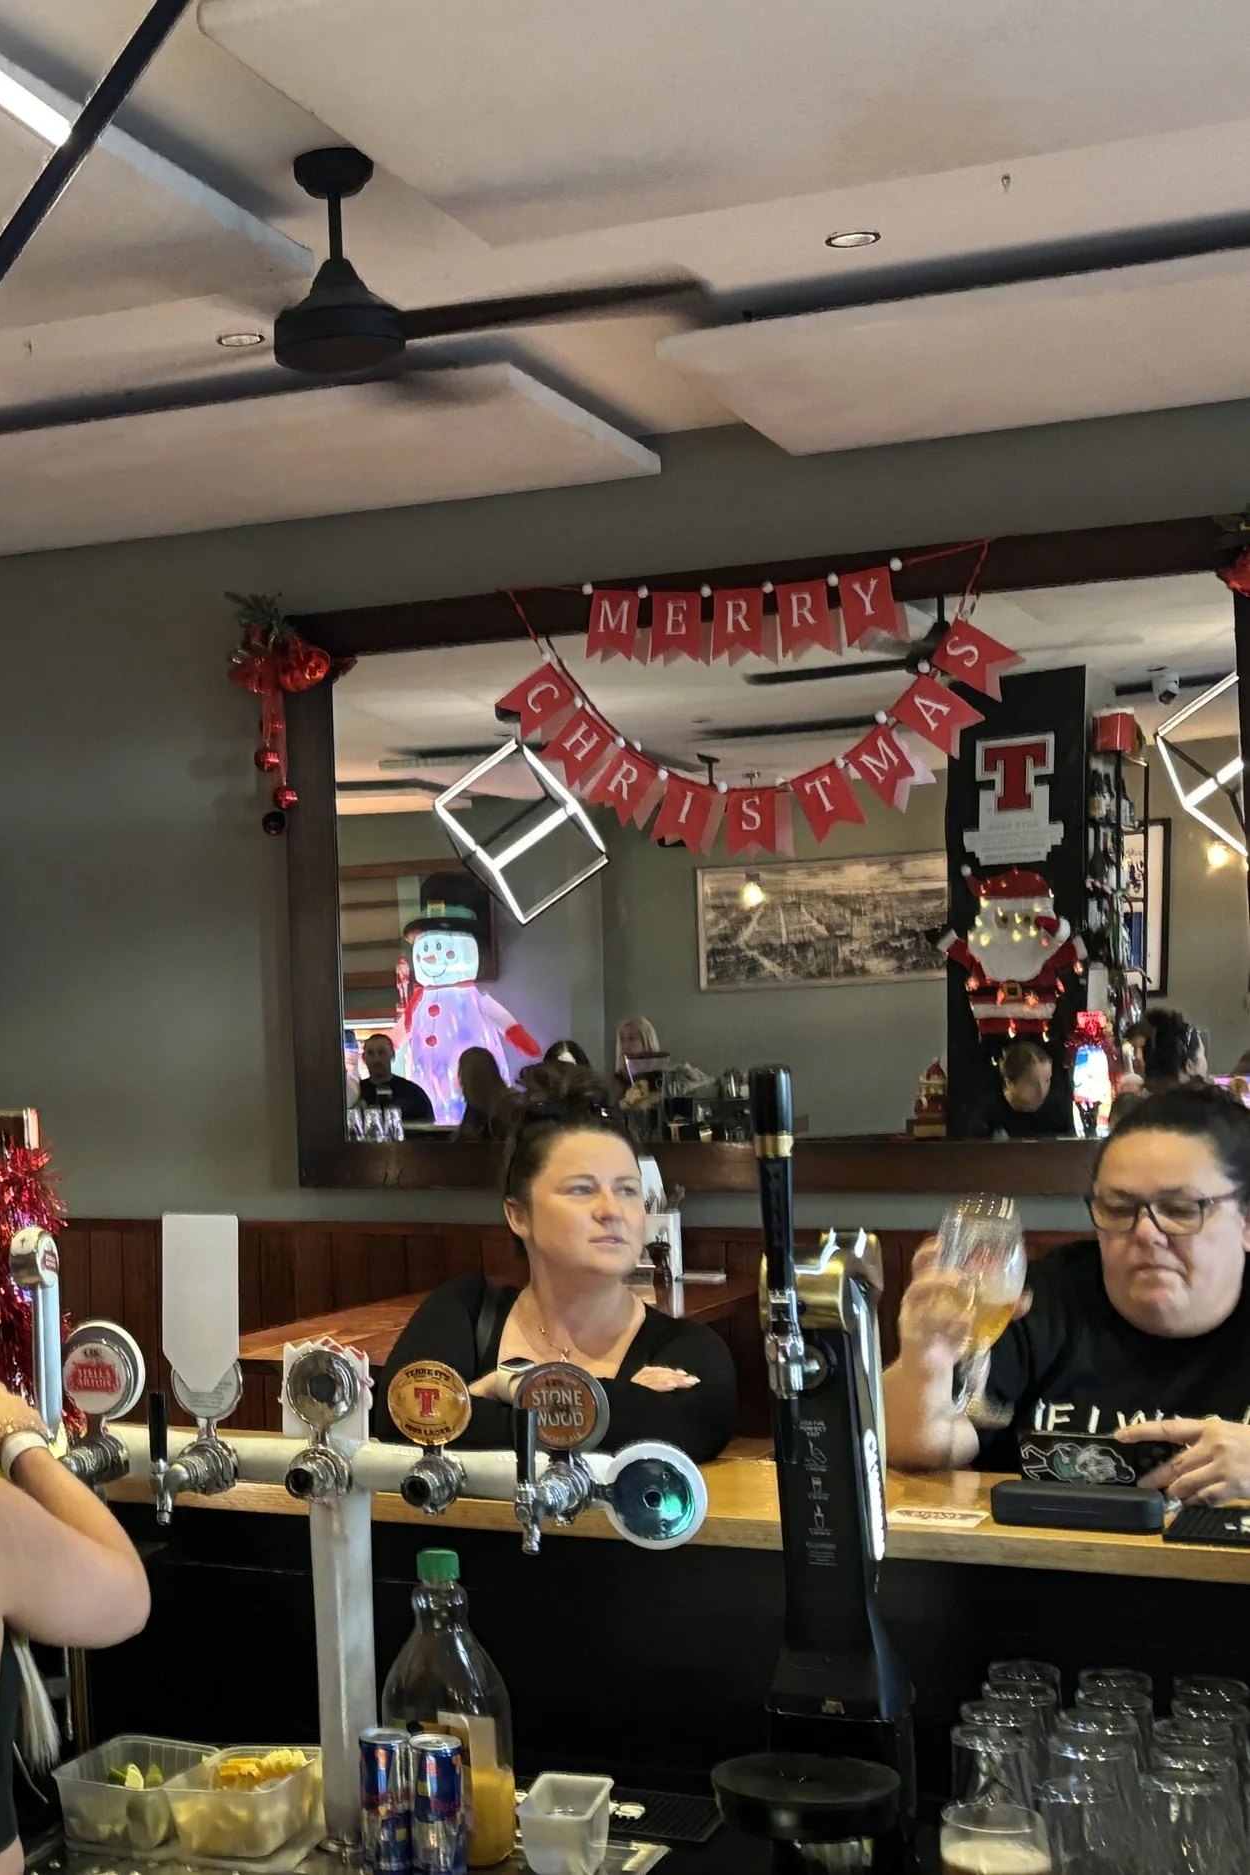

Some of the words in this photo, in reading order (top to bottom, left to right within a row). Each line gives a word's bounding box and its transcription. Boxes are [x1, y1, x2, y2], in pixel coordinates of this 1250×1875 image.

[597, 577, 880, 635] MERRY
[526, 636, 979, 831] CHRISTMAS
[414, 1387, 440, 1418] T
[531, 1389, 583, 1406] STONE
[536, 1411, 585, 1427] WOOD
[1034, 1398, 1075, 1431] IF
[1088, 1404, 1100, 1434] I
